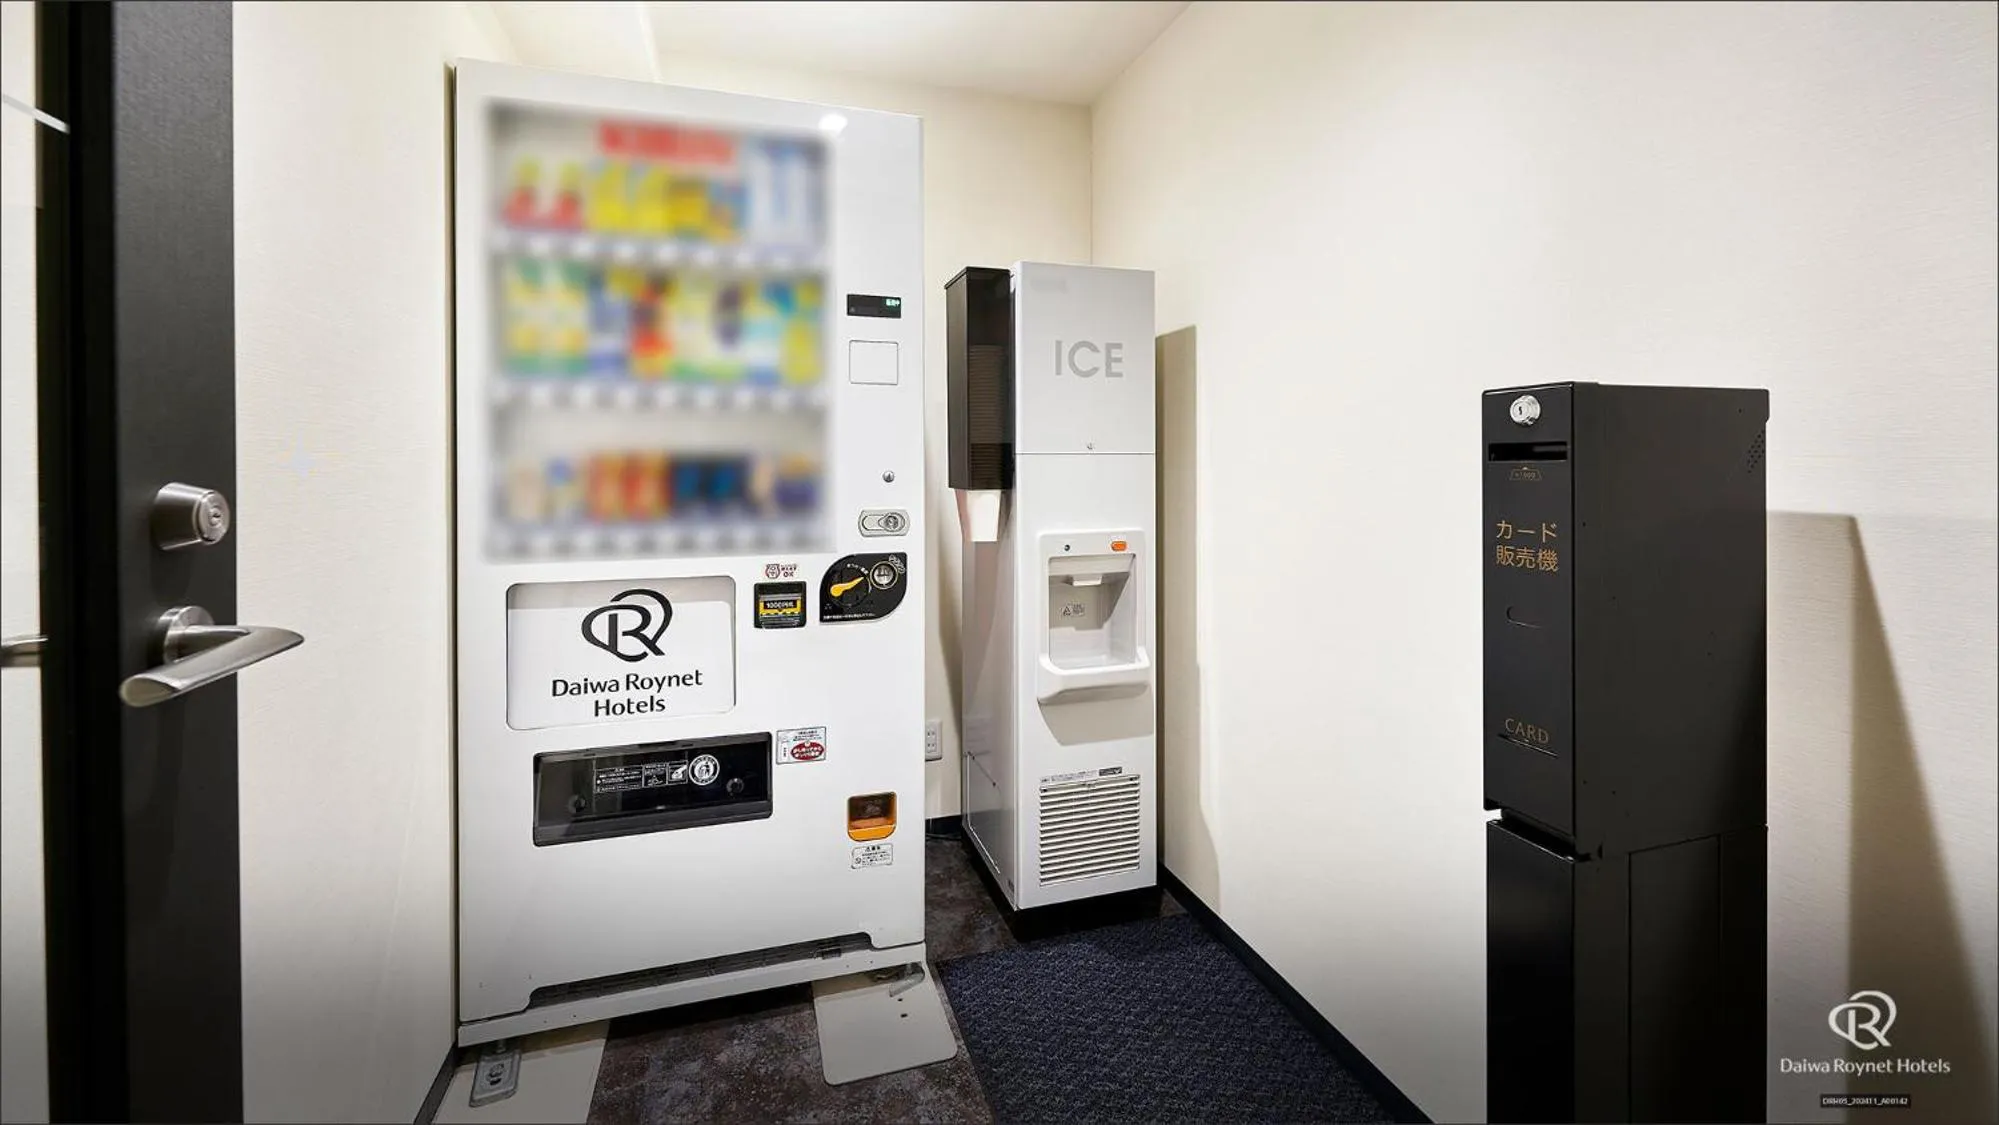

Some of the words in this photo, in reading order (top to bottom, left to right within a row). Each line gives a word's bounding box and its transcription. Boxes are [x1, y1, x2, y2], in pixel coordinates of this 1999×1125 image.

[1055, 340, 1123, 378] ICE
[1496, 520, 1557, 543] カード
[1496, 545, 1559, 572] 販売機
[552, 678, 620, 697] Daiwa
[625, 669, 703, 693] Roynet
[594, 695, 666, 717] Hotels
[1505, 718, 1549, 744] CARD
